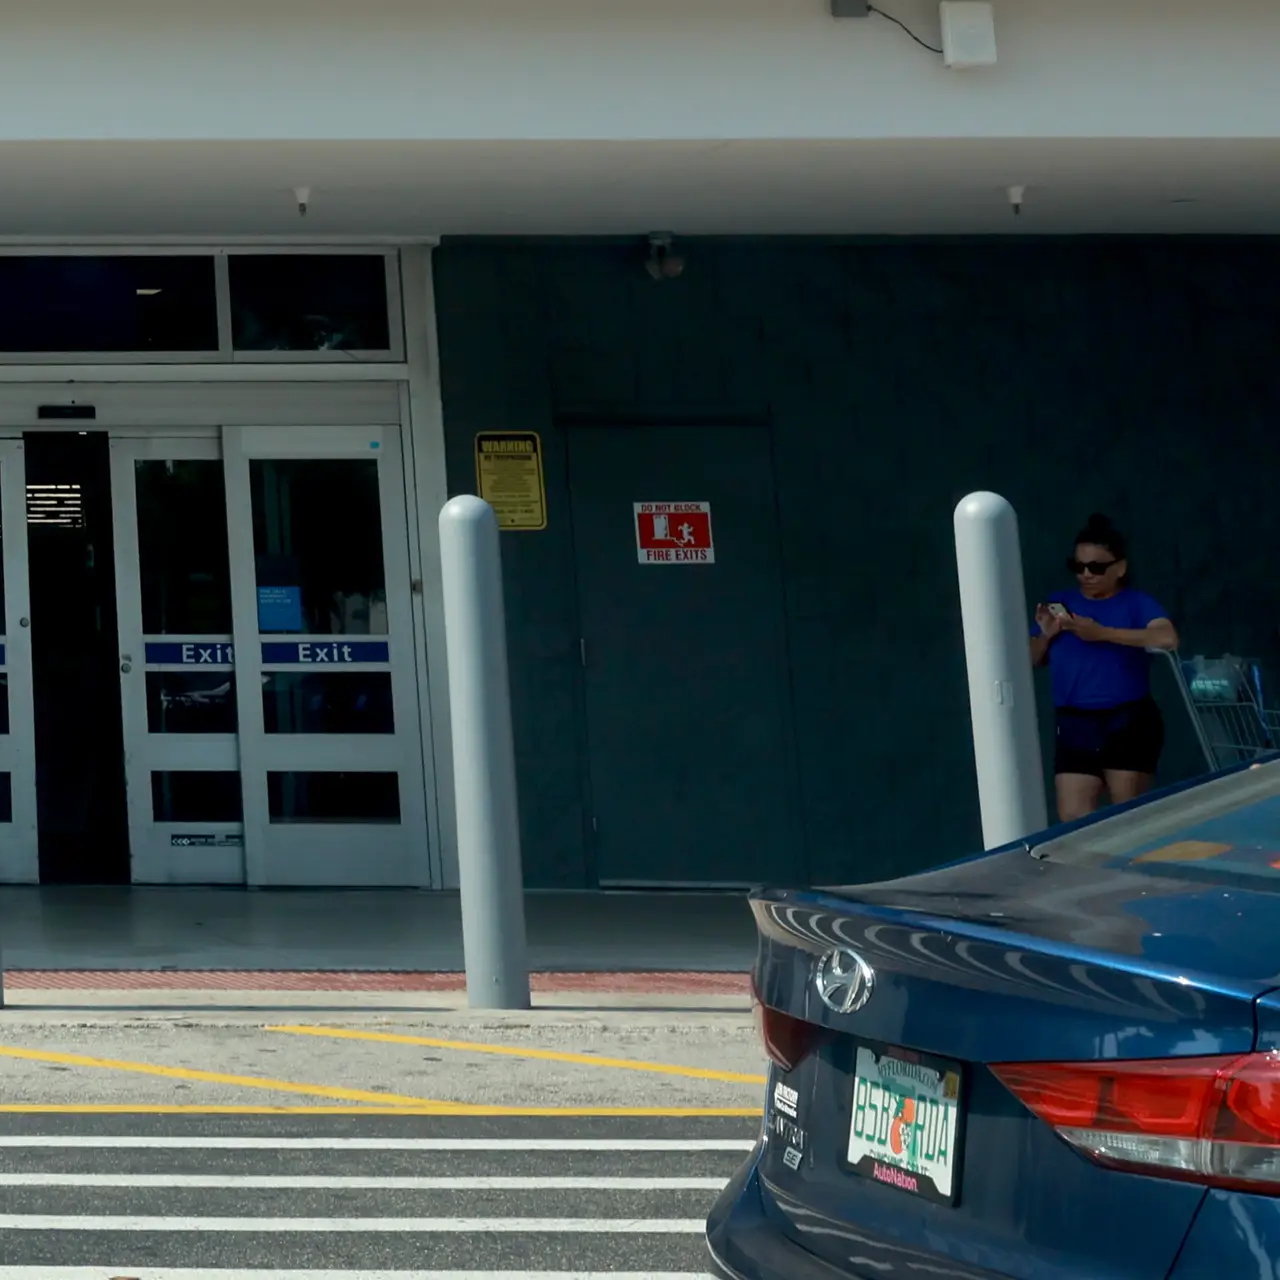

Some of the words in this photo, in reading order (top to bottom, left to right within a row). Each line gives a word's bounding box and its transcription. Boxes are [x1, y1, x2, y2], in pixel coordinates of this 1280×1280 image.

[481, 439, 534, 452] WARNING
[641, 504, 652, 512] DO
[655, 504, 671, 512] NOT
[674, 503, 701, 512] BLOCK
[646, 549, 672, 562] FIRE
[675, 549, 708, 561] EXITS
[182, 644, 234, 663] Exit
[298, 643, 352, 662] Exit
[873, 1161, 918, 1190] AutoNation
